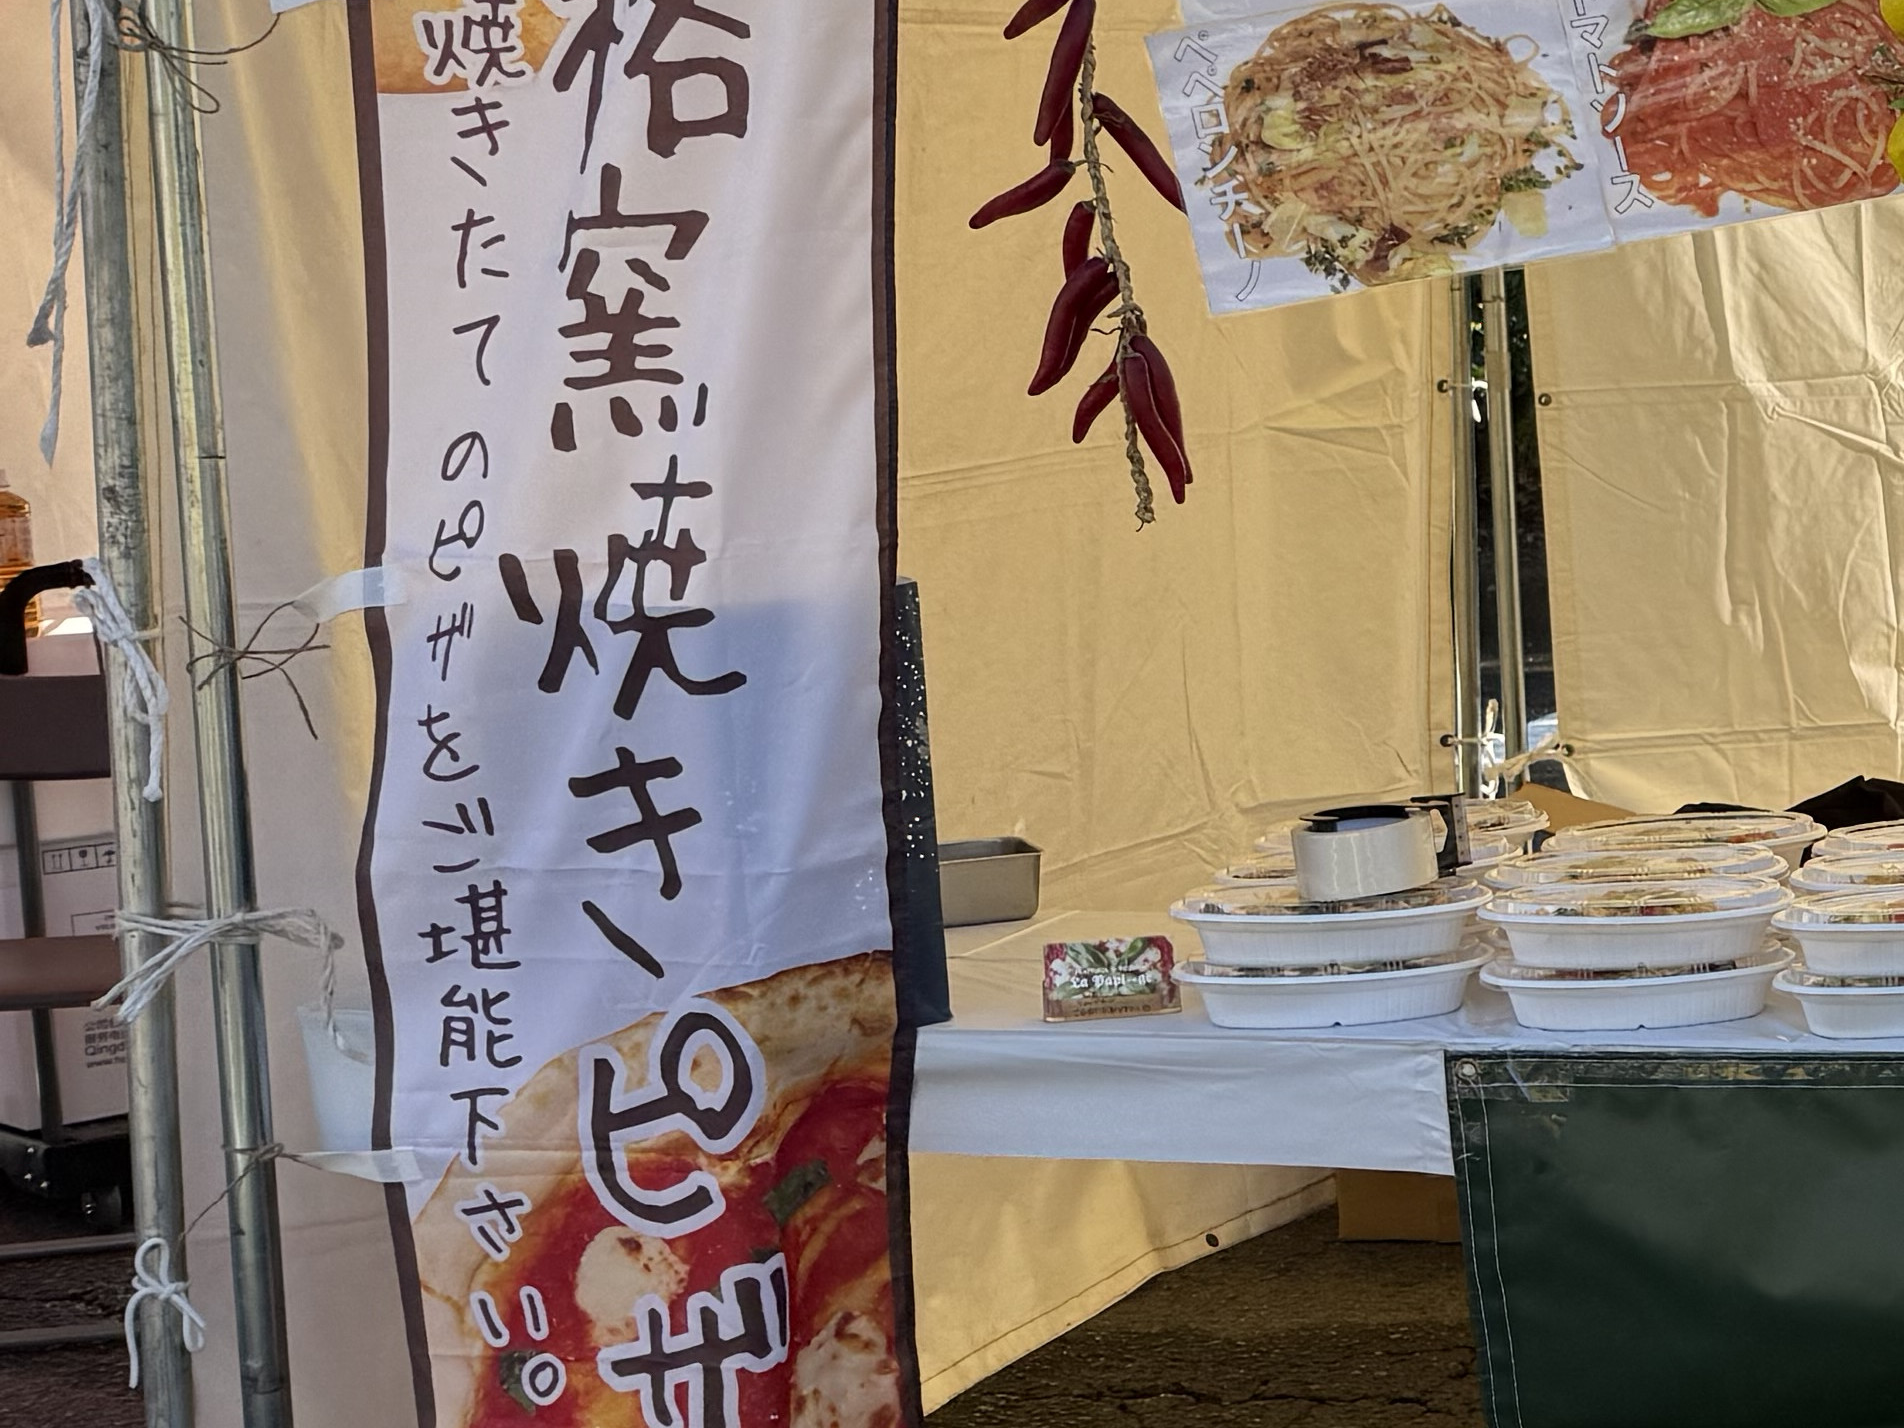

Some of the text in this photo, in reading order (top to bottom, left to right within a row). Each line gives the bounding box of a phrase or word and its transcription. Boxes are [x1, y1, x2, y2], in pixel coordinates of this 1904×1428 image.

[1173, 29, 1266, 302] ペペロンチーノ
